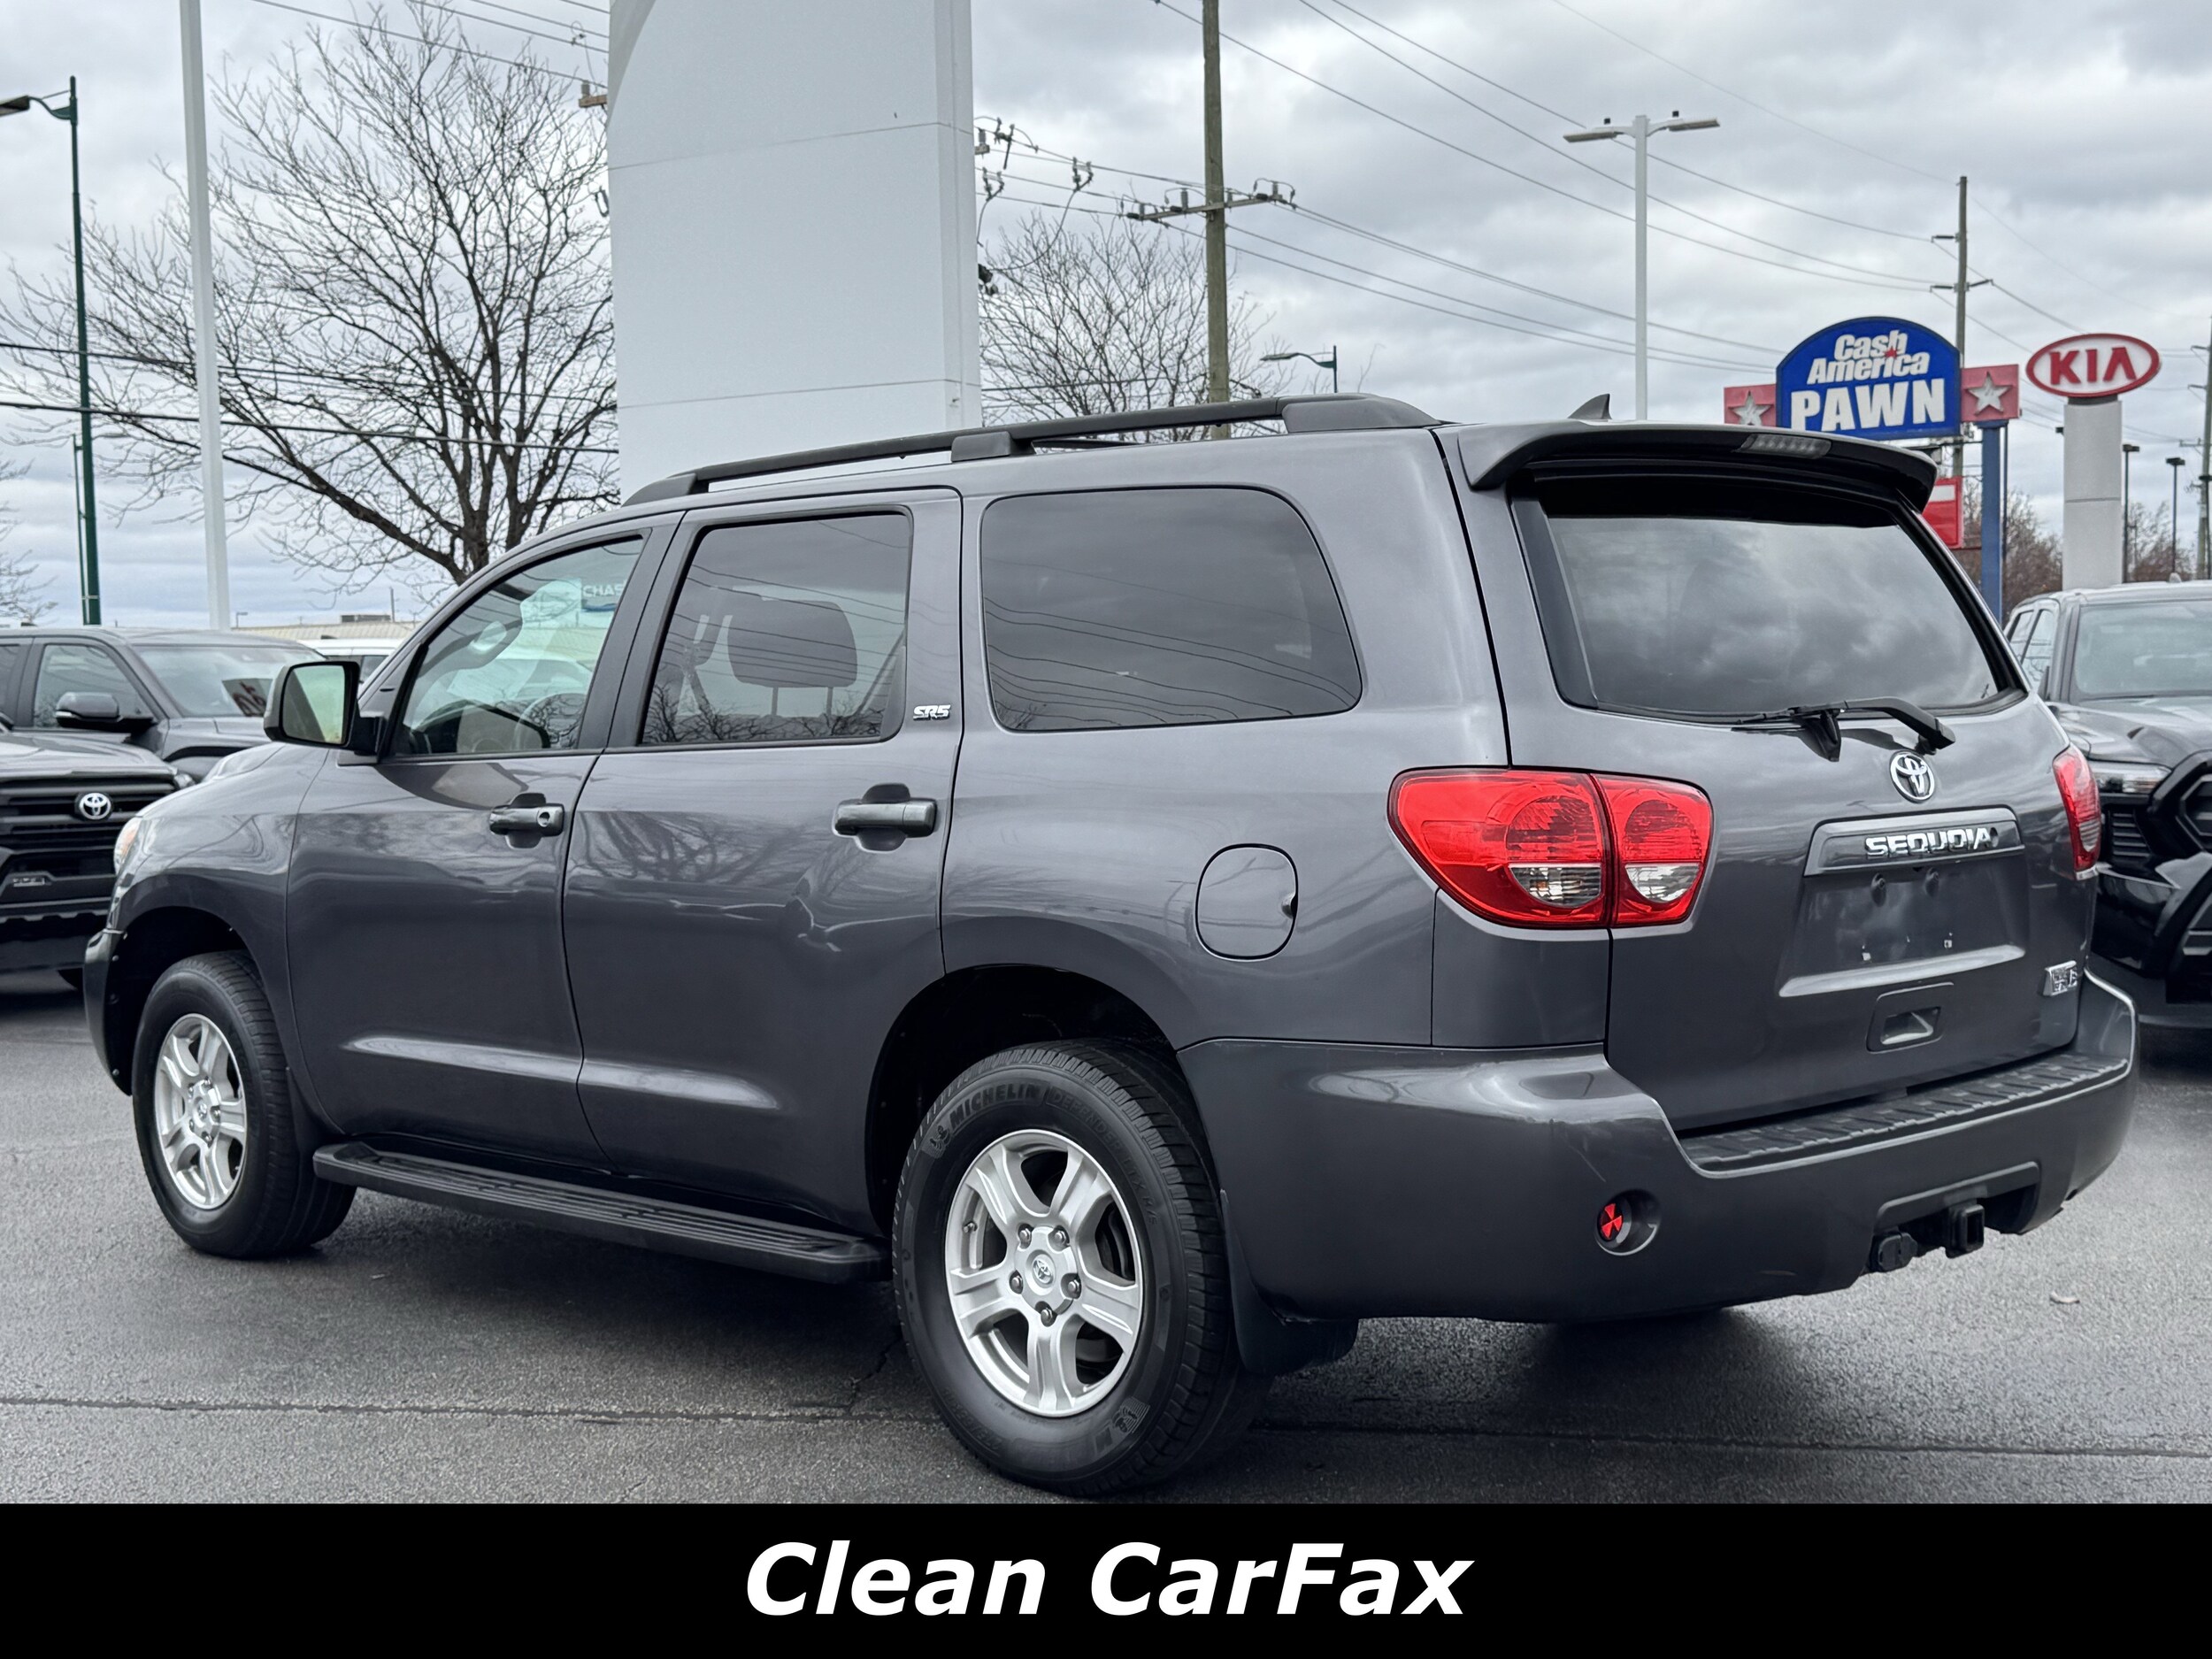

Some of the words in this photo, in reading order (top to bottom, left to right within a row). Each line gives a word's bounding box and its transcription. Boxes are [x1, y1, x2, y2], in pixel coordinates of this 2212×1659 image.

[1833, 329, 1909, 362] Cash
[1806, 351, 1931, 385] America
[2049, 346, 2138, 386] KIA
[1790, 378, 1945, 432] PAWN
[583, 580, 625, 597] CHAS
[912, 704, 951, 720] SR5
[1865, 826, 1993, 859] SEQUOIA
[949, 1081, 1040, 1132] MICHELIN
[1049, 1088, 1123, 1156] DEFENDER
